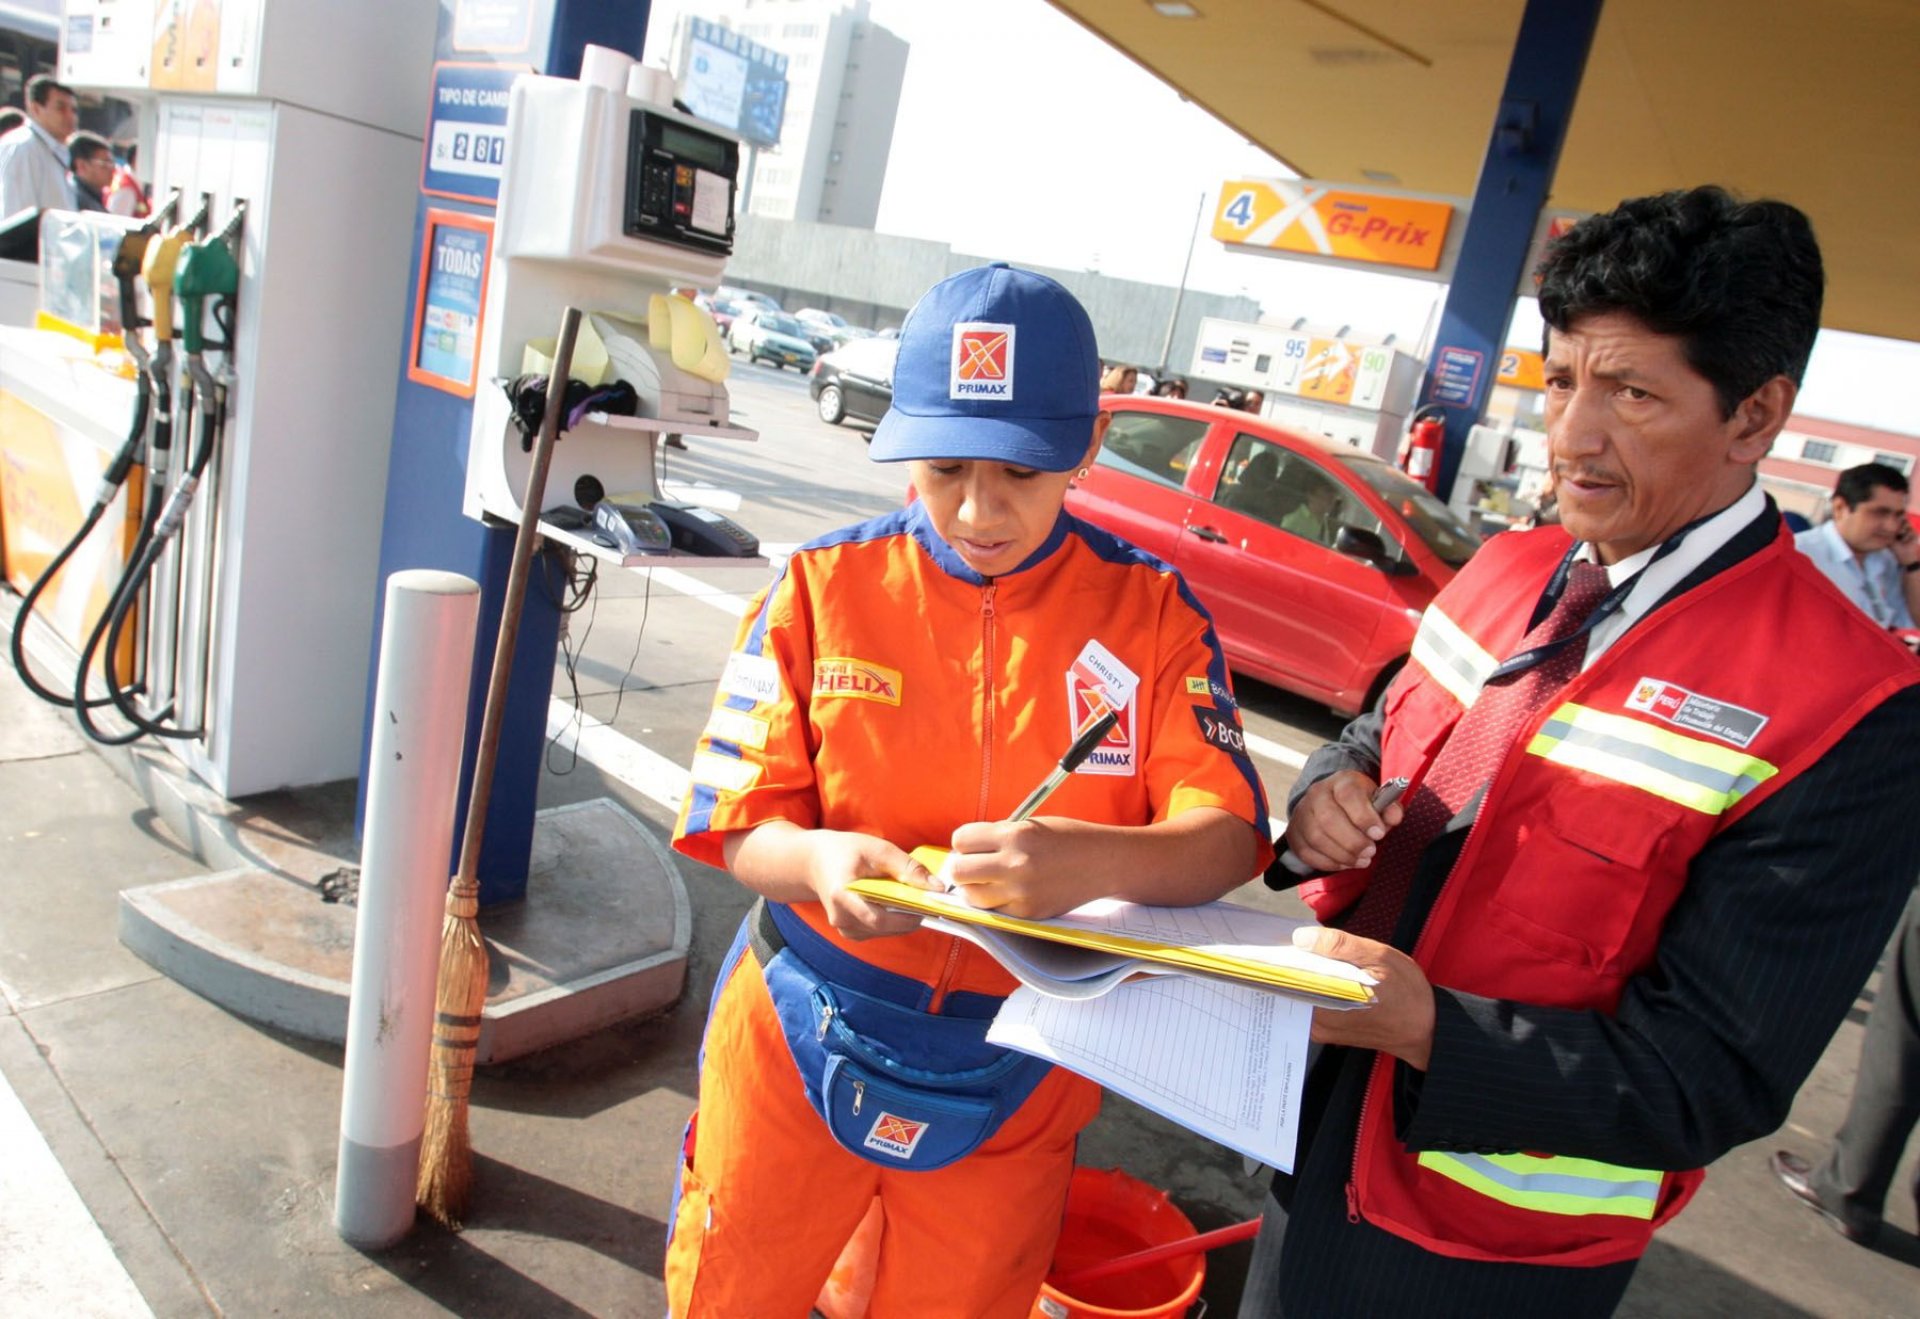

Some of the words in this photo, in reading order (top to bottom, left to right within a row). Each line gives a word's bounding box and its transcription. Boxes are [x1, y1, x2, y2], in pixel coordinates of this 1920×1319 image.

[439, 87, 461, 105] TIPO
[462, 88, 477, 106] DE
[1226, 195, 1252, 225] 4
[1326, 213, 1430, 246] G-Prix
[438, 246, 481, 278] TODAS
[1285, 339, 1306, 358] 95
[1363, 351, 1386, 373] 90
[1502, 356, 1518, 373] 2
[958, 384, 1007, 394] PRIMAX
[1088, 655, 1124, 690] CHRISTY
[817, 674, 893, 697] HELIX
[1218, 722, 1244, 750] BCP
[1089, 752, 1131, 766] RIMAX
[870, 1138, 908, 1154] PRIMAX
